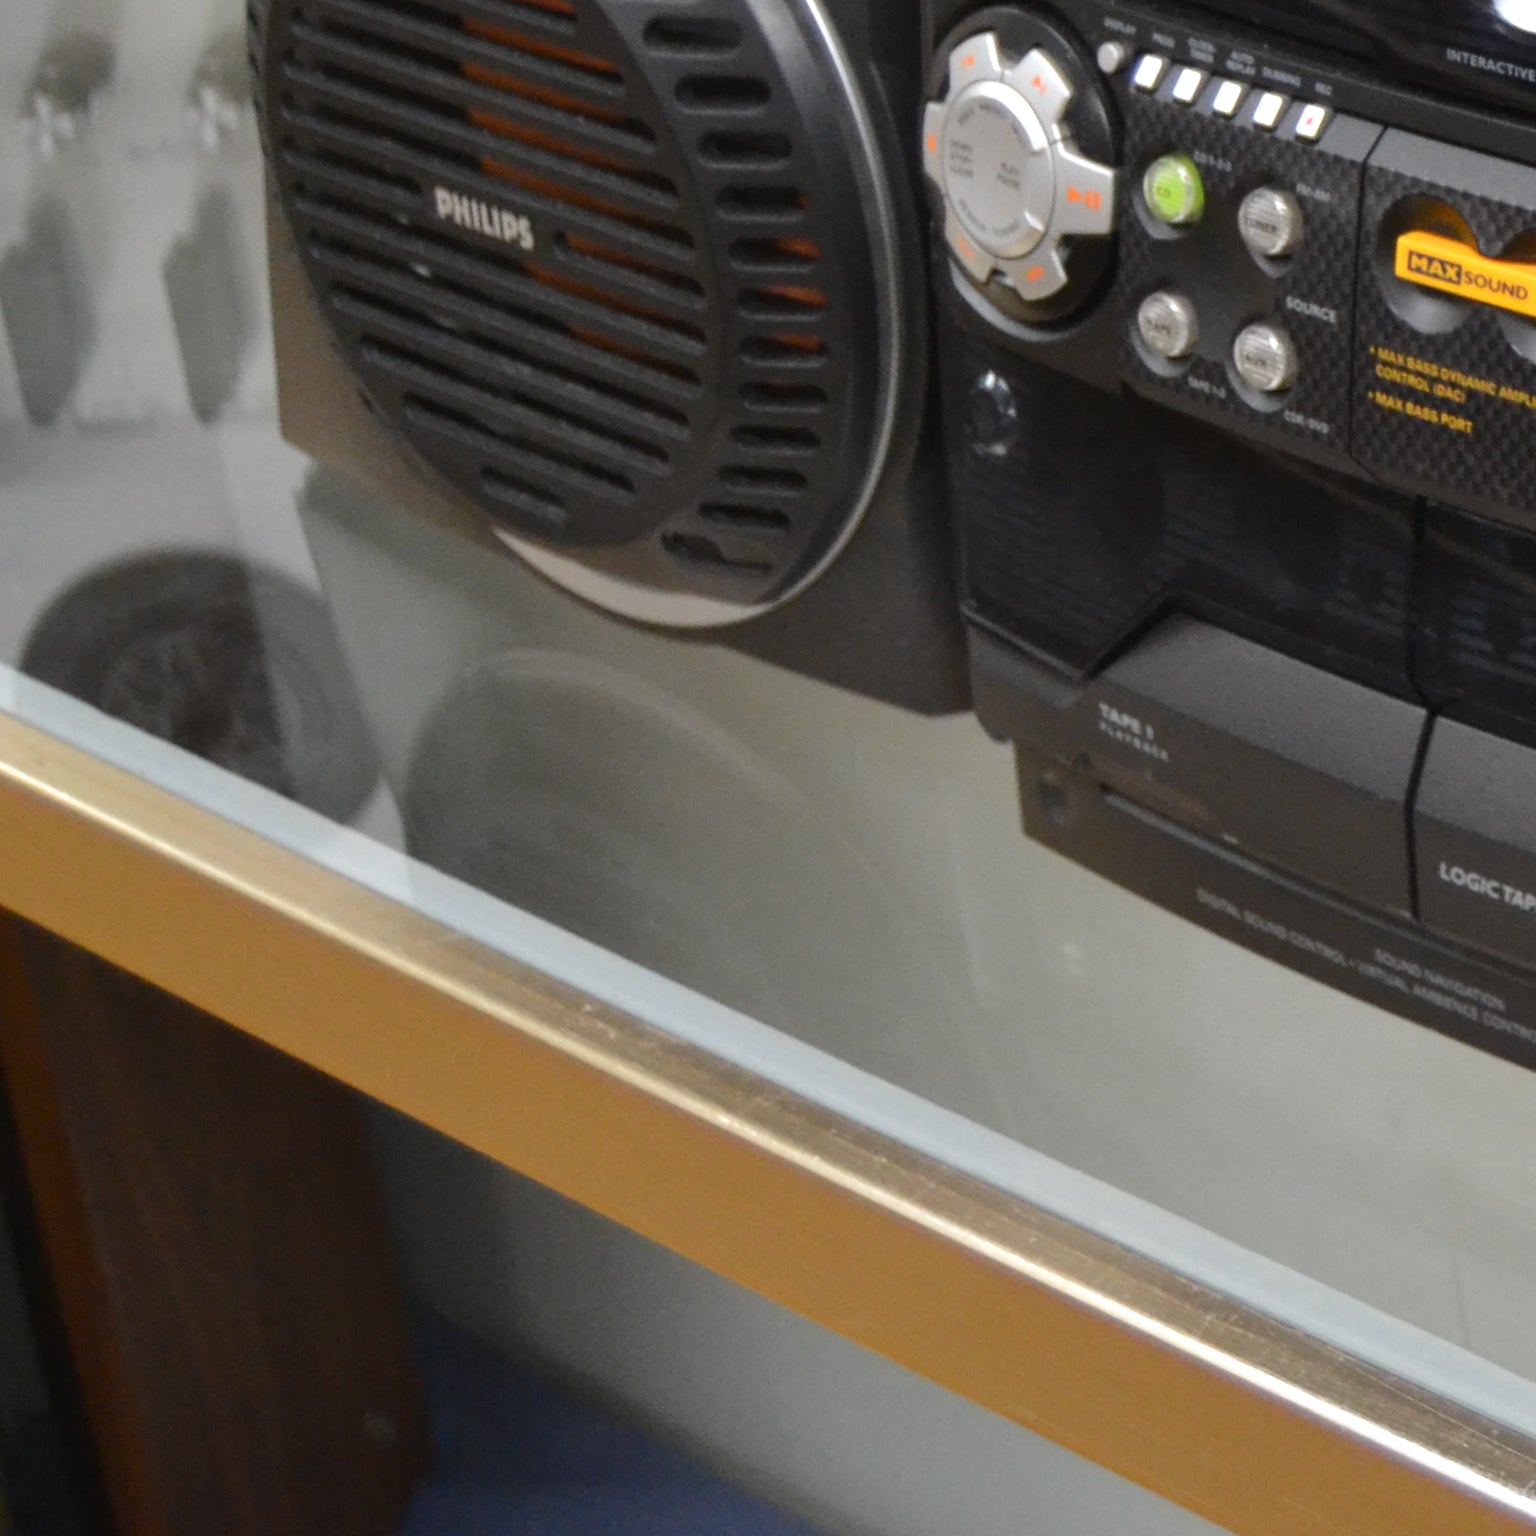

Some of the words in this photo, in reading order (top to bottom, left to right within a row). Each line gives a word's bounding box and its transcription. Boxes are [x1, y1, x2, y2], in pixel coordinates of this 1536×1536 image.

[1446, 47, 1536, 83] INTERACTIVE
[433, 184, 535, 252] PHILIPS
[1463, 270, 1529, 301] SOUND
[1286, 295, 1338, 324] SOURCE
[1375, 363, 1430, 393] CONTROL
[1378, 346, 1404, 366] MAX
[1407, 354, 1439, 378] BASS
[1440, 368, 1497, 397] DYNAMIC
[1375, 390, 1404, 412] MAX
[1406, 401, 1439, 424] BASS
[1440, 412, 1474, 436] PORT
[1099, 701, 1142, 736] TAPE
[1438, 861, 1501, 901] LOGIC
